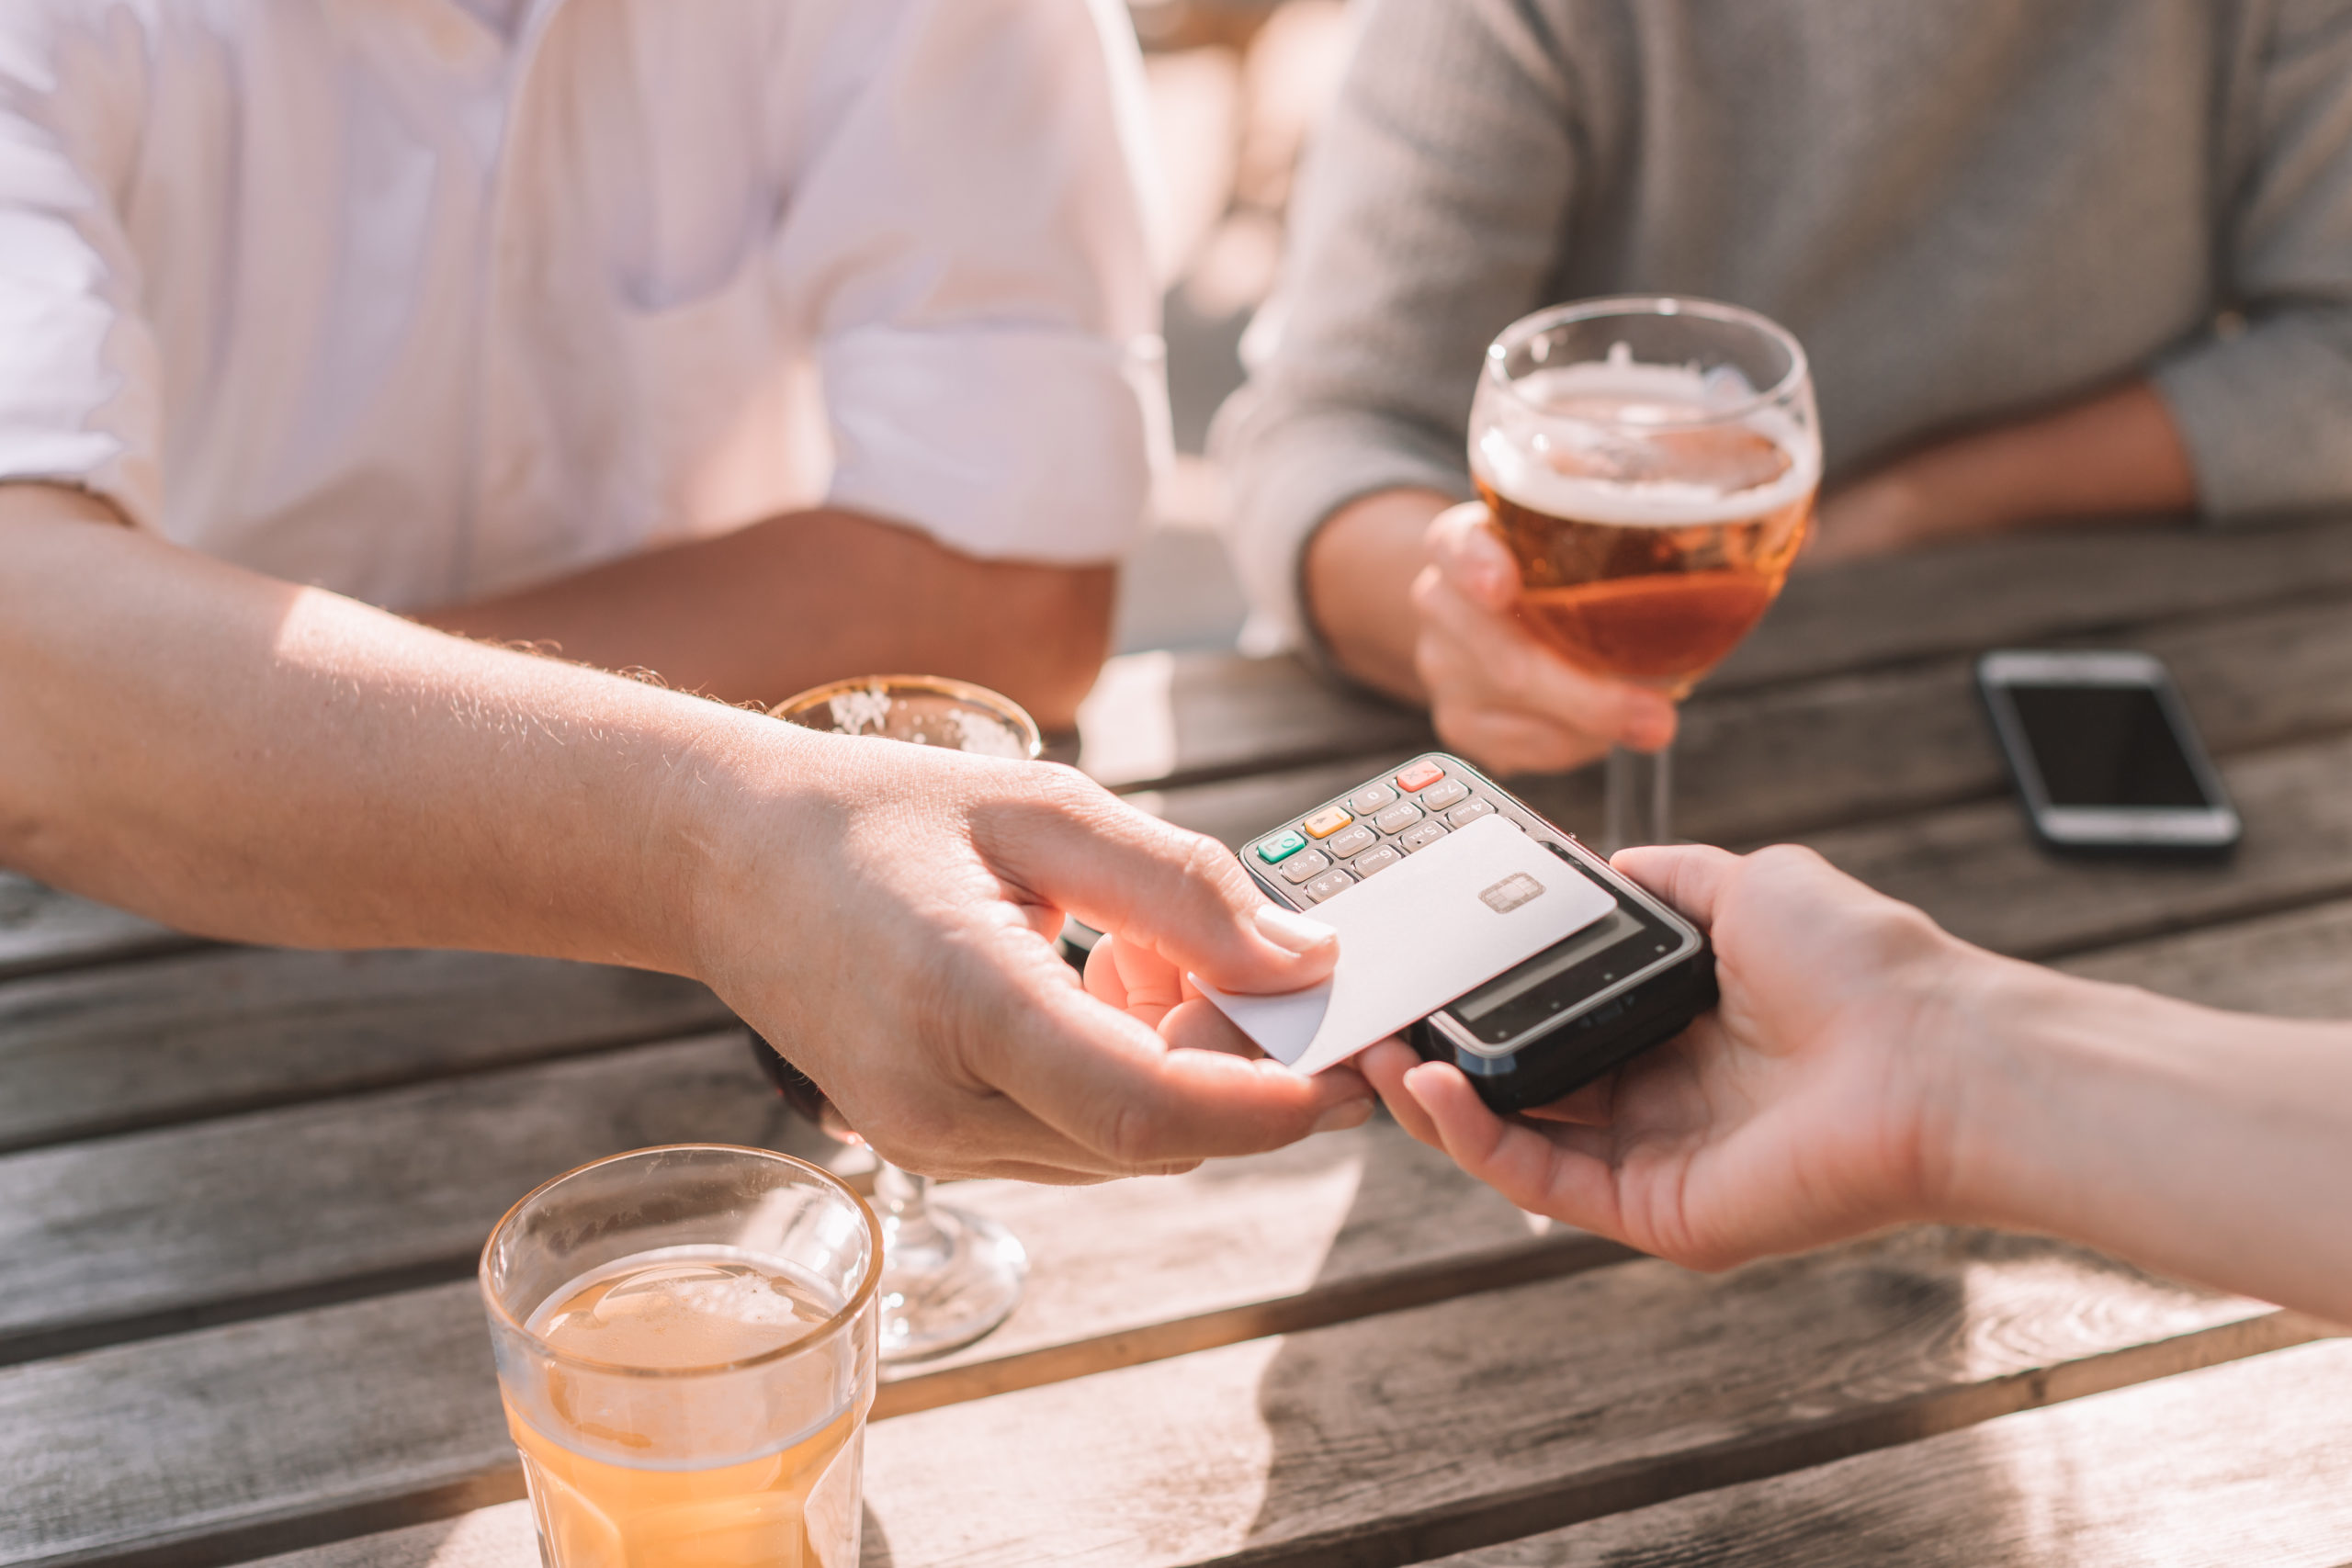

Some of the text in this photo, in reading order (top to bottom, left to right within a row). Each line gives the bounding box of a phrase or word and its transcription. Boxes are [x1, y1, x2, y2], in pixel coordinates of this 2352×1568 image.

[1448, 784, 1459, 795] 7
[1366, 791, 1380, 800] 0
[1400, 806, 1413, 815] 8
[1470, 803, 1482, 812] 4
[1353, 829, 1366, 839] 9
[1424, 826, 1437, 836] 5
[1362, 850, 1392, 864] 6 MNO
